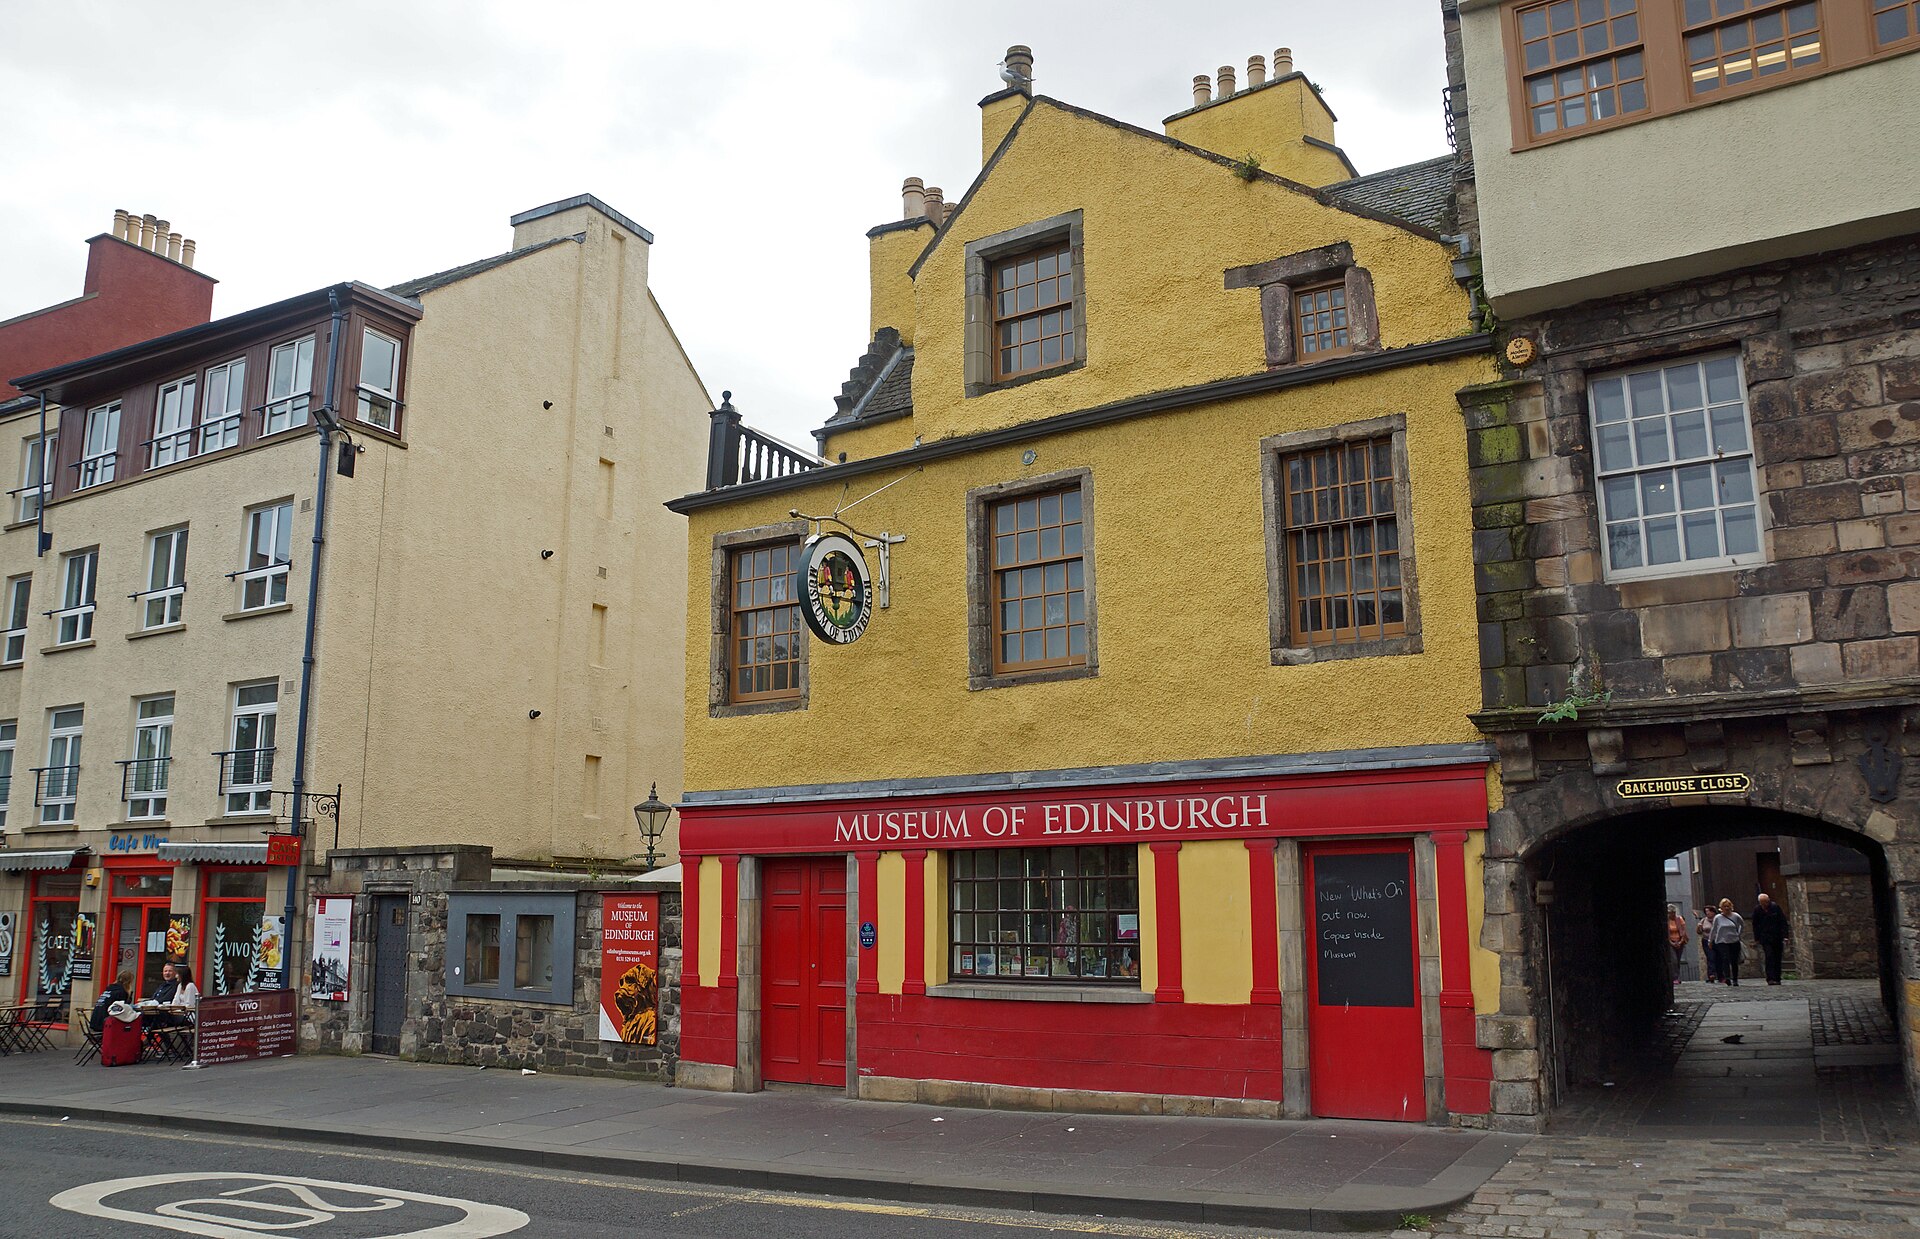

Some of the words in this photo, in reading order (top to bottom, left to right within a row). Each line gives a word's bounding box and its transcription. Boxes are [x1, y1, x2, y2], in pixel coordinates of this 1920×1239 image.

[809, 565, 829, 629] MUSEUM
[829, 628, 840, 639] OF
[842, 580, 872, 643] EDINBURGH
[1624, 780, 1696, 794] BAKEHOUSE
[1701, 777, 1742, 790] CLOSE
[834, 809, 972, 842] MUSEUM
[982, 806, 1027, 837] OF
[1042, 794, 1270, 835] EDINBURGH
[109, 833, 139, 853] Cafe
[270, 853, 297, 862] BISTRO
[1320, 891, 1342, 902] New
[611, 910, 648, 922] MUSEUM
[1321, 909, 1341, 921] out
[605, 929, 655, 941] EDINBURGH
[1354, 928, 1385, 940] inside
[47, 936, 70, 950] CAFE
[225, 942, 250, 958] VIVO
[1324, 949, 1357, 959] Museum
[239, 1002, 258, 1011] VIVO
